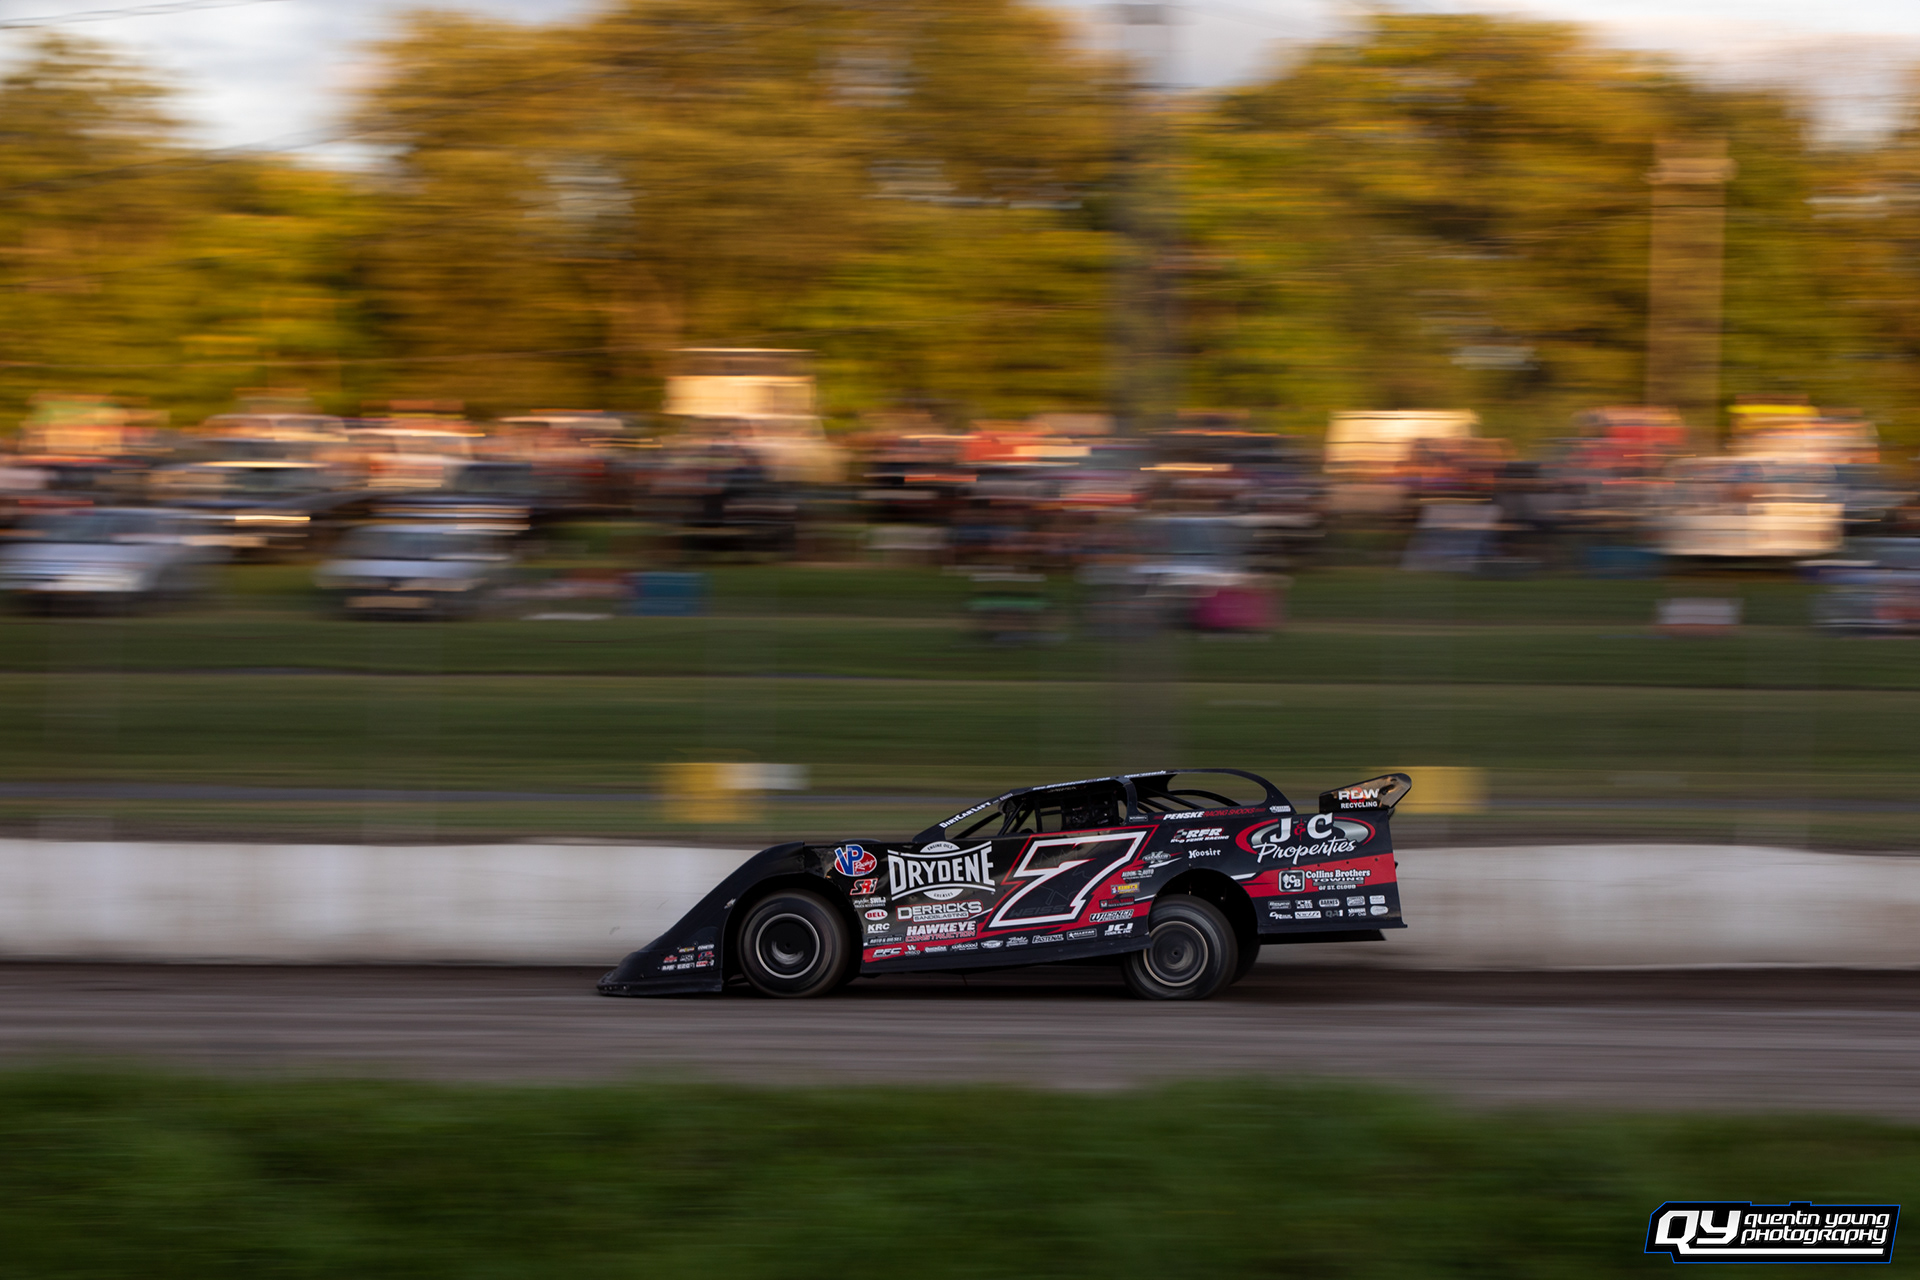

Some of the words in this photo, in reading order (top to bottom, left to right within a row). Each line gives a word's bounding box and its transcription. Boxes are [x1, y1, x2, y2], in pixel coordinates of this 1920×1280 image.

[1340, 801, 1378, 809] RECYCLING
[1163, 811, 1205, 820] PENSKE
[1204, 809, 1228, 817] RACING
[1228, 807, 1255, 816] SHOCKS
[1186, 827, 1223, 838] RFR
[1270, 817, 1292, 843] J
[1293, 819, 1307, 840] &
[1307, 812, 1333, 839] C
[1188, 848, 1222, 859] Hoosier
[1252, 836, 1356, 865] Properties
[835, 844, 864, 876] VP
[854, 859, 876, 871] Racing
[887, 845, 996, 895] DRYDENE
[1305, 870, 1333, 879] Collins
[1335, 869, 1370, 877] Brothers
[989, 831, 1147, 928] 7
[897, 901, 982, 920] DERRICK'S
[914, 912, 968, 921] SANDBLASTING
[1325, 909, 1344, 917] QA1
[867, 922, 890, 932] KRC
[906, 921, 976, 936] HAWKEYE
[905, 930, 975, 942] CONSTRUCTION
